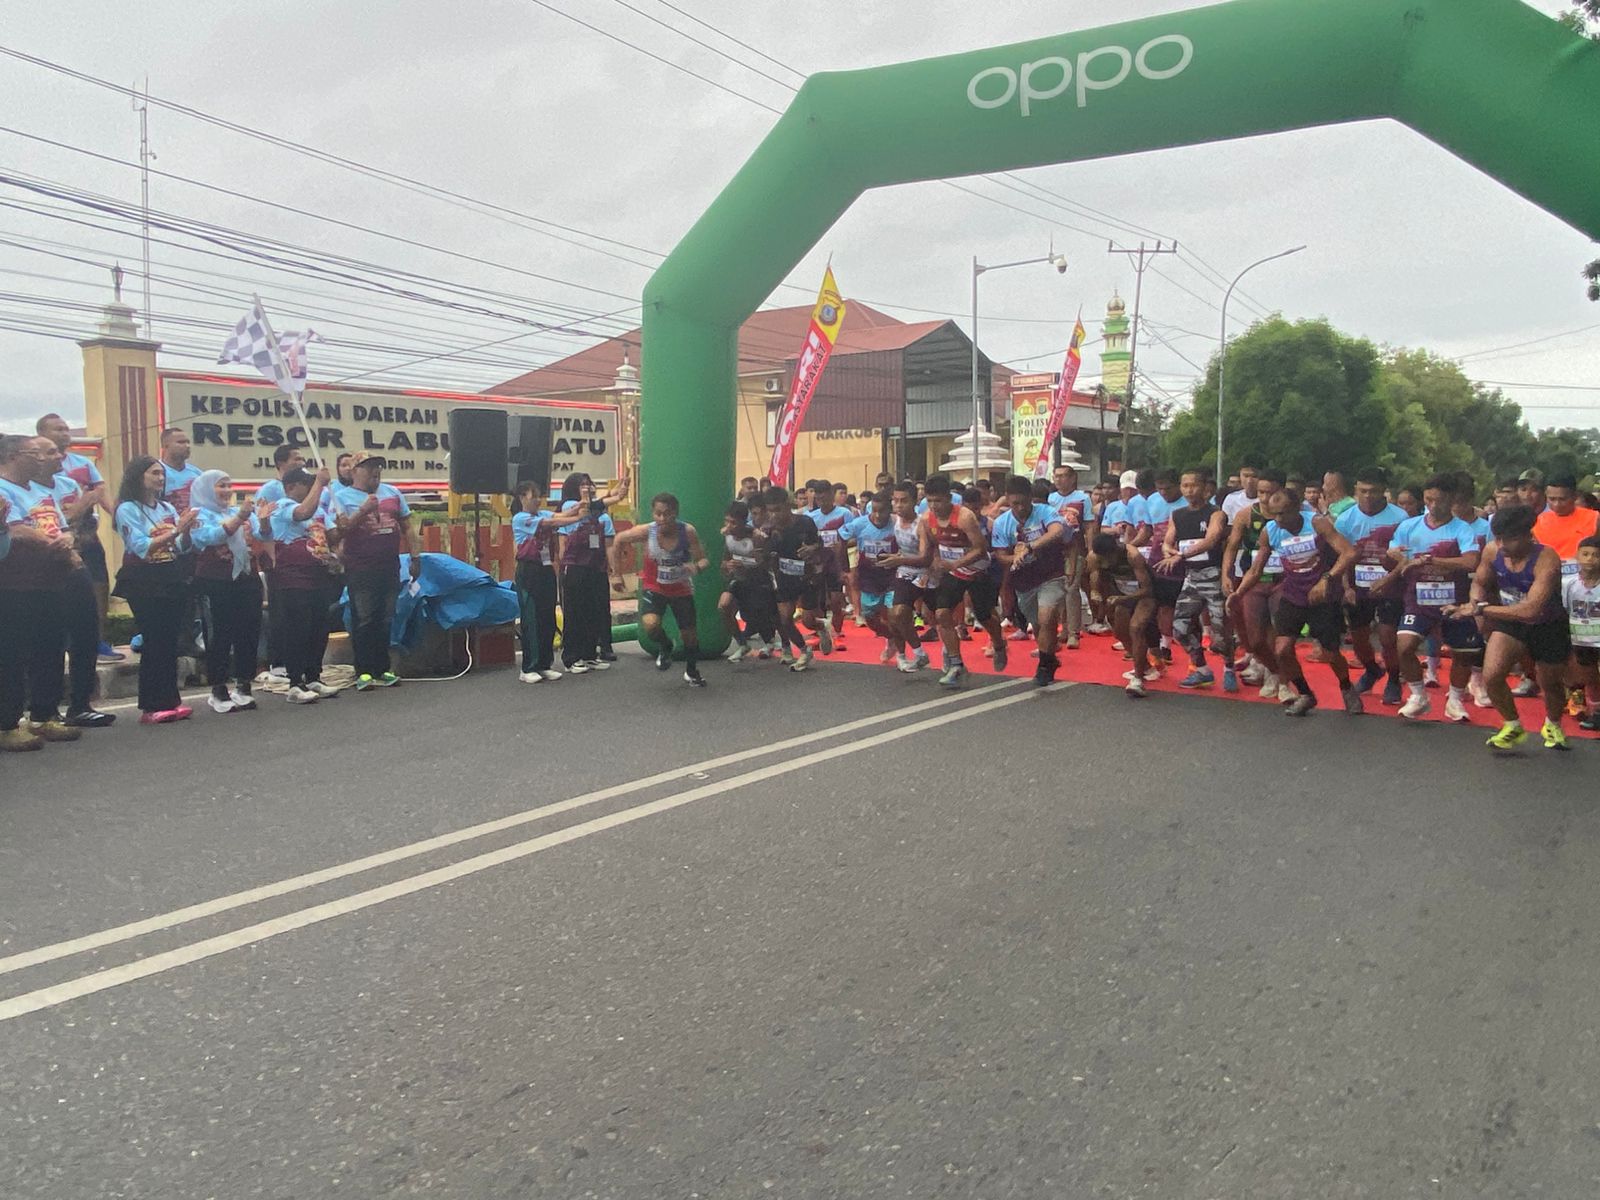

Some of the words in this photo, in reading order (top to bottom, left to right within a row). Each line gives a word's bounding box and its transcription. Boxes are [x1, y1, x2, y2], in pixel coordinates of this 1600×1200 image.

[353, 405, 438, 424] DAERAH
[553, 417, 605, 433] UTARA
[192, 423, 345, 449] RESOR
[1018, 428, 1043, 437] POLIC
